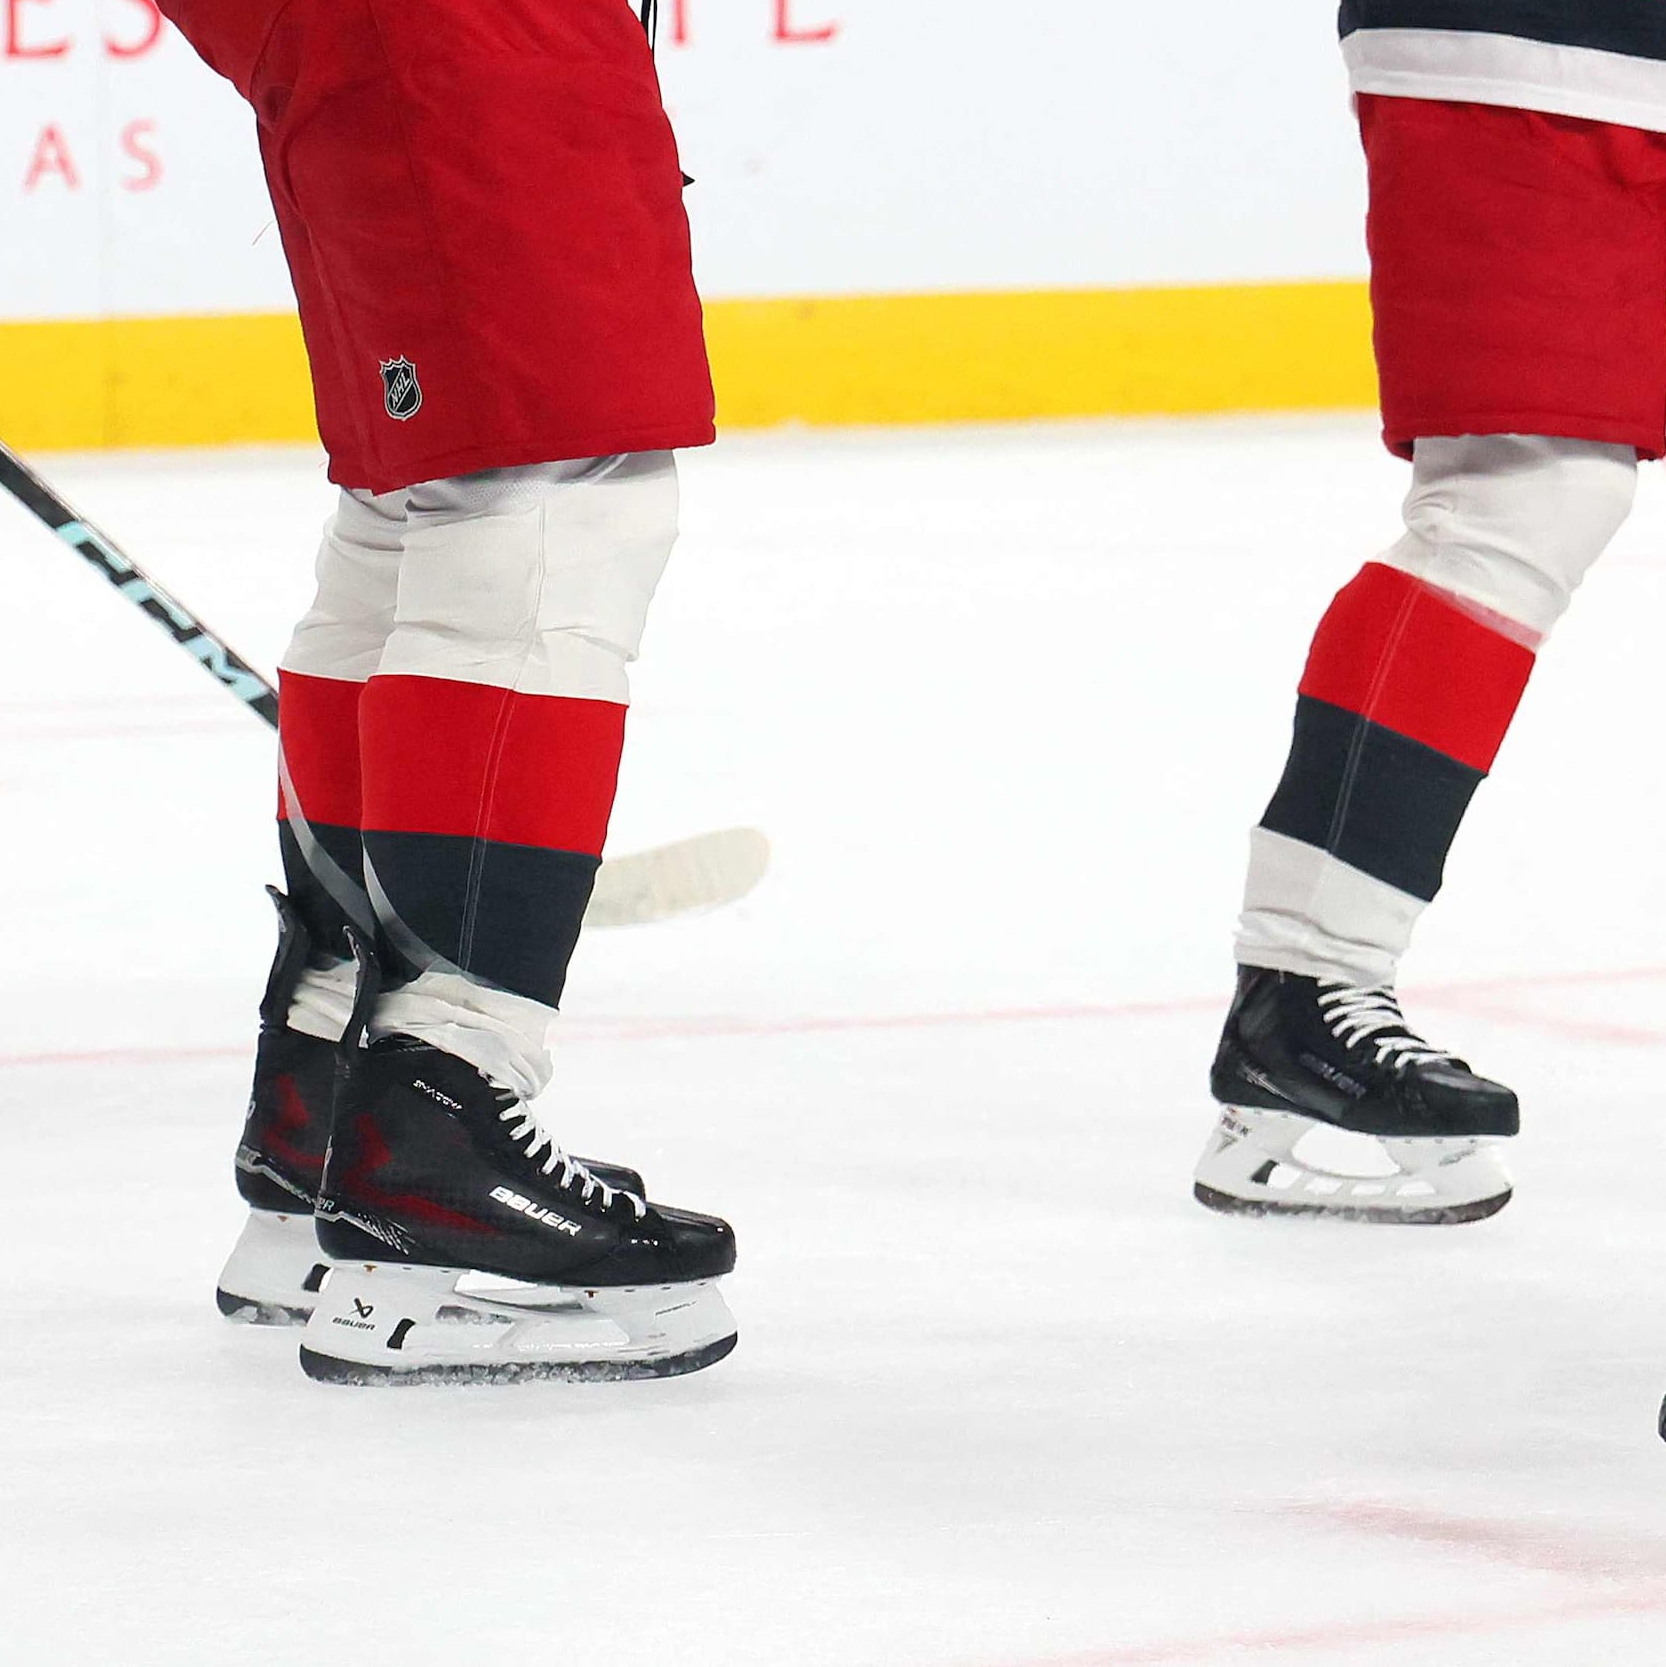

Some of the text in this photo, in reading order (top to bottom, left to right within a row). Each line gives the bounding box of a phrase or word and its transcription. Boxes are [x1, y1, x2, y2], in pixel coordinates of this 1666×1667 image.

[64, 519, 269, 705] CCM
[488, 1185, 583, 1237] BAUER
[331, 1315, 377, 1332] BAUER
